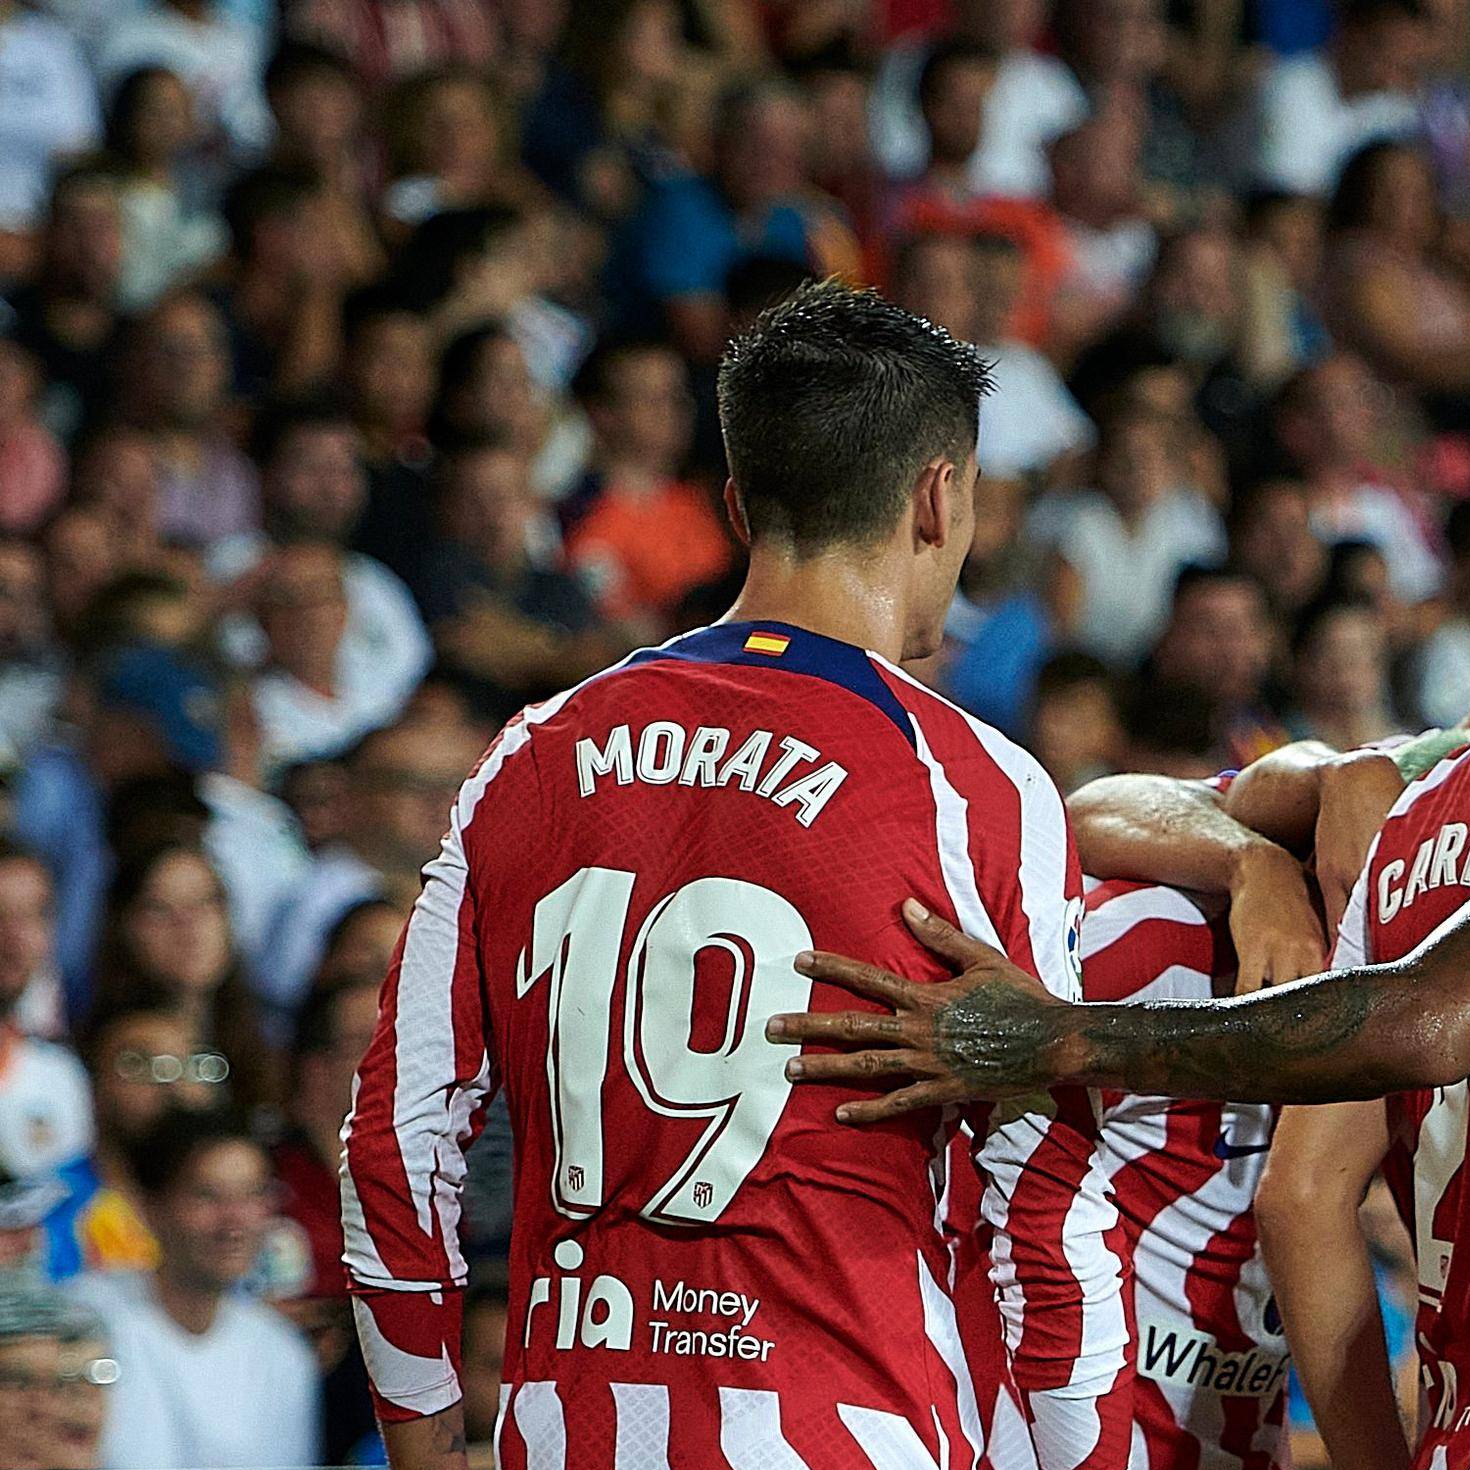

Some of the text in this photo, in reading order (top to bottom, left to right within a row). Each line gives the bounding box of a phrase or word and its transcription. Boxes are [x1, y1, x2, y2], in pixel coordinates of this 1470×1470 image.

[575, 720, 849, 828] MORATA
[515, 866, 816, 1225] 19
[524, 1239, 760, 1351] ria Money
[648, 1321, 776, 1362] Transfer
